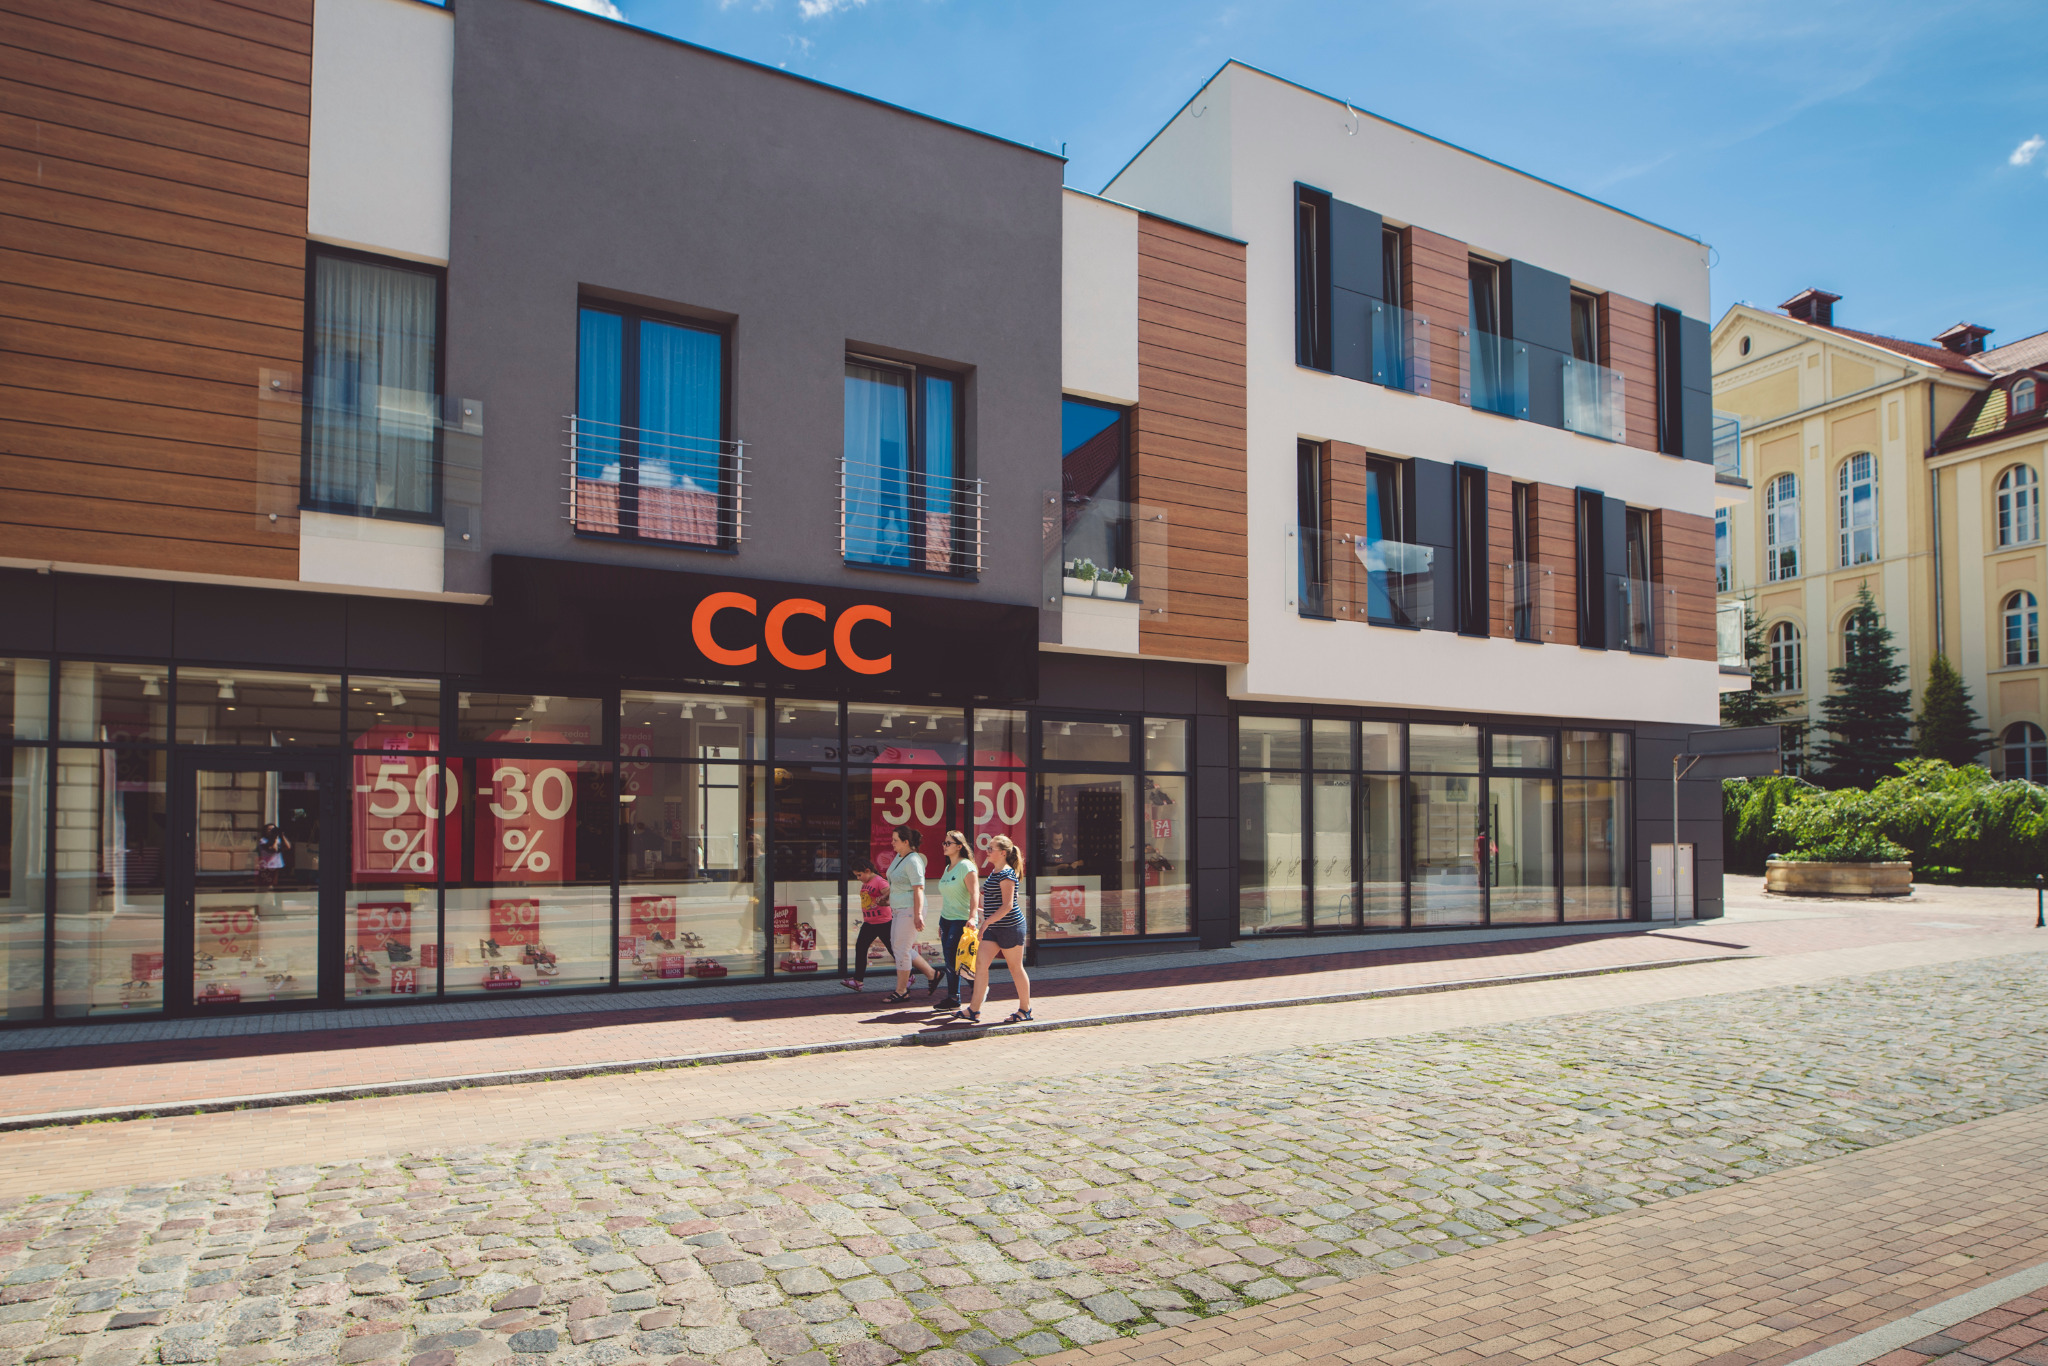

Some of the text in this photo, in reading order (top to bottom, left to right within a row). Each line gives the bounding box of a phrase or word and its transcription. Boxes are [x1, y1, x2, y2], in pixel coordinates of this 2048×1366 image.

[692, 592, 892, 675] CCC
[356, 764, 459, 819] -50
[479, 767, 574, 820] -30
[874, 780, 945, 826] -30
[958, 782, 1025, 826] -50
[382, 829, 434, 873] %
[503, 830, 551, 872] %
[1053, 889, 1083, 907] -30
[205, 910, 254, 935] -30
[361, 906, 407, 932] -50
[495, 902, 536, 925] -30
[636, 900, 673, 922] -30
[1065, 909, 1076, 920] %
[219, 937, 239, 953] %
[508, 927, 524, 942] %
[395, 970, 413, 981] SA
[395, 982, 413, 993] LE
